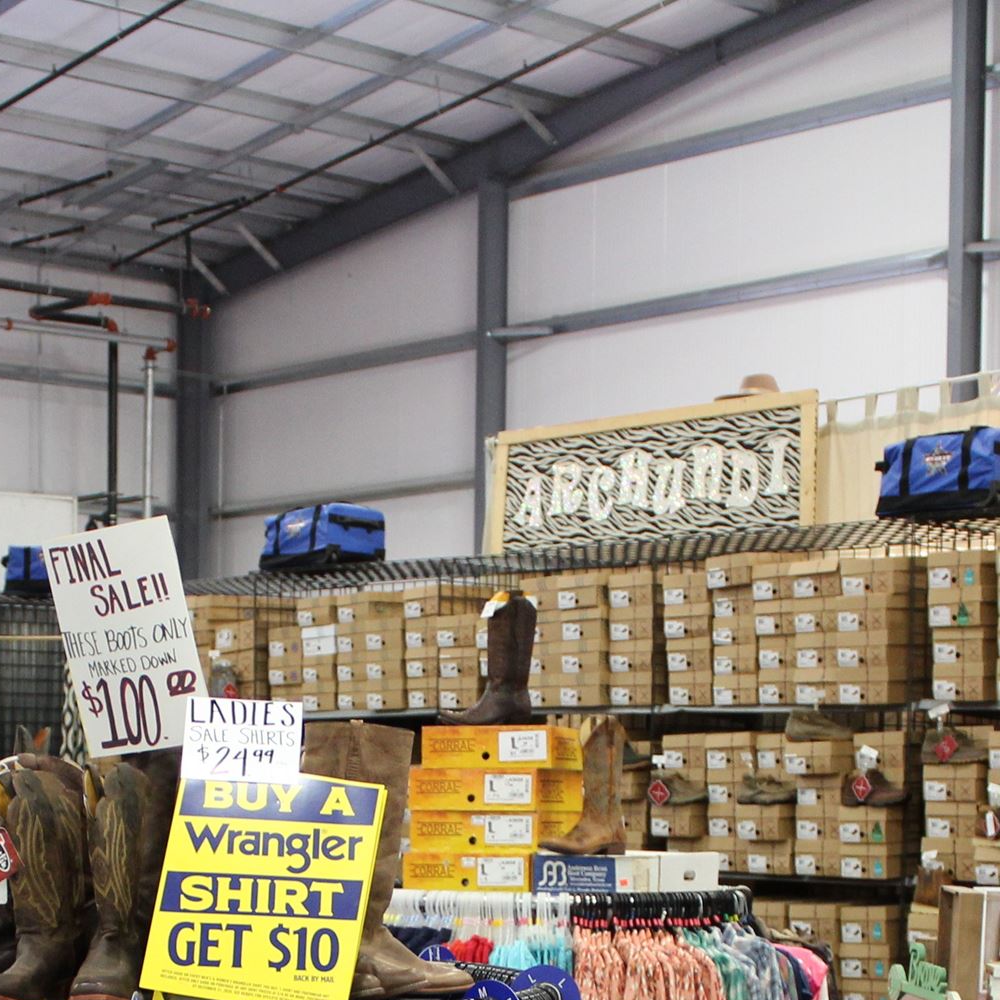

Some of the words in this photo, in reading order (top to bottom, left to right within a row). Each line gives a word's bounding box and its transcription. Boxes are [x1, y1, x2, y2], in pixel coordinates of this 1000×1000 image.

[511, 436, 791, 527] ARCHUNDI
[48, 538, 122, 585] FINAL
[90, 572, 171, 617] SALE!!
[62, 631, 102, 659] THESE
[105, 625, 148, 653] BOOTS
[152, 617, 189, 644] ONLY
[88, 657, 138, 678] MARKED
[141, 649, 177, 671] DOWN
[190, 698, 296, 727] LADIES
[189, 726, 229, 744] SALE
[239, 728, 296, 747] SHIRTS
[432, 738, 474, 751] CORRAL
[202, 780, 303, 813] BUY
[319, 786, 355, 817] A
[419, 780, 460, 793] CORRAL
[185, 821, 364, 874] Wrangler
[419, 823, 460, 835] CORRAL
[179, 875, 345, 917] SHIRT
[167, 922, 253, 968] GET
[268, 924, 340, 972] $10
[478, 986, 488, 998] M
